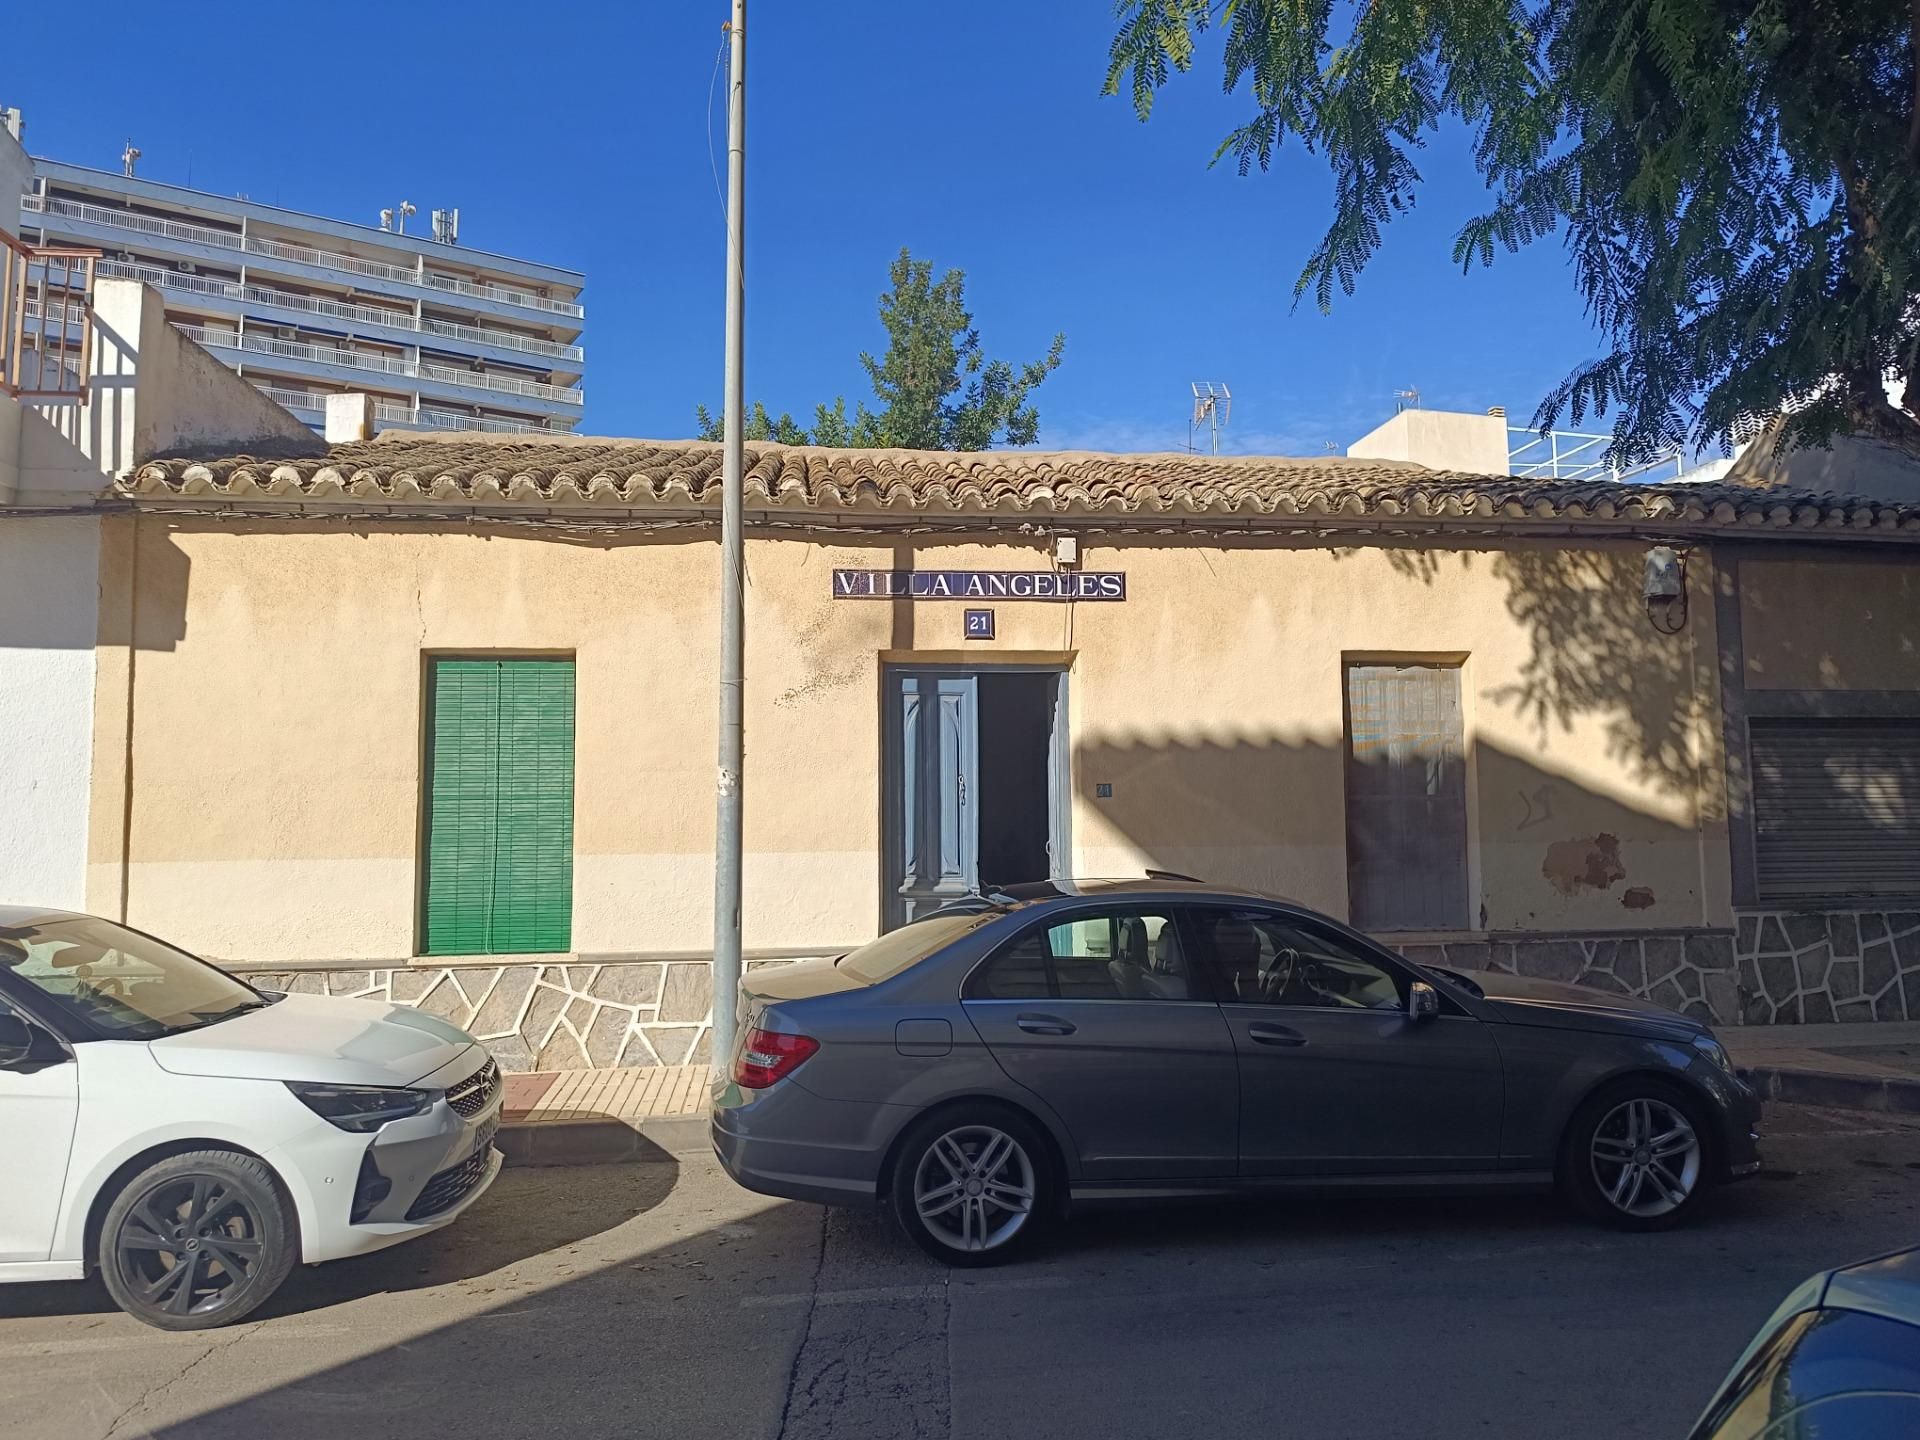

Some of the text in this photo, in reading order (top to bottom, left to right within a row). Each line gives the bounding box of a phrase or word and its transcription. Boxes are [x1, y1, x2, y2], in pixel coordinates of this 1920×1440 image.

[838, 572, 1121, 597] VILLA ANGELES
[970, 616, 988, 630] 21
